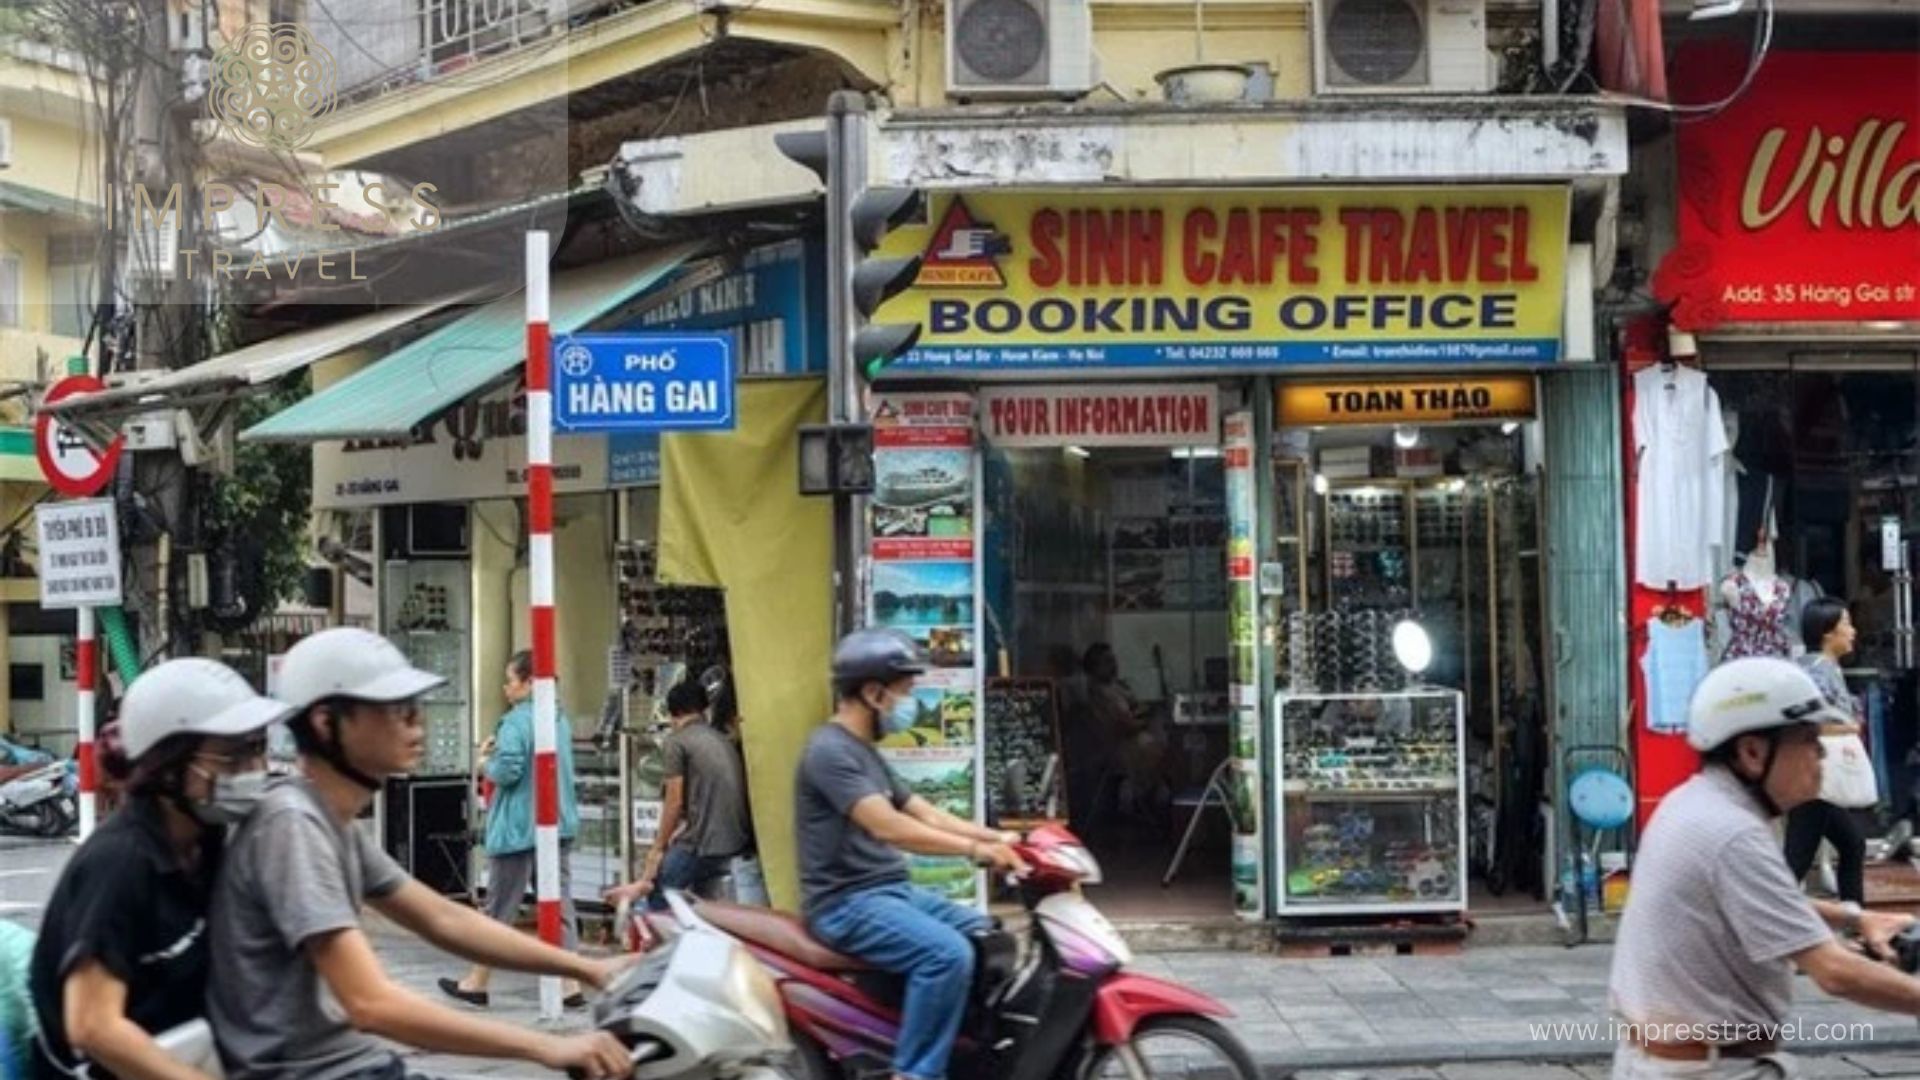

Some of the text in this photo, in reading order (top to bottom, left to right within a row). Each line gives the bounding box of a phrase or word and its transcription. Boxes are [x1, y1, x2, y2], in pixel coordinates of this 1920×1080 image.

[1029, 205, 1540, 289] SINH CAFE TRAVEL
[1774, 284, 1796, 303] 35
[1855, 282, 1889, 303] Gai
[929, 293, 1517, 335] BOOKING OFFICE
[624, 346, 677, 371] PHỐ
[568, 374, 718, 414] HÀNG GAI
[990, 397, 1049, 436] TOUR
[1054, 395, 1209, 435] INFORMATION
